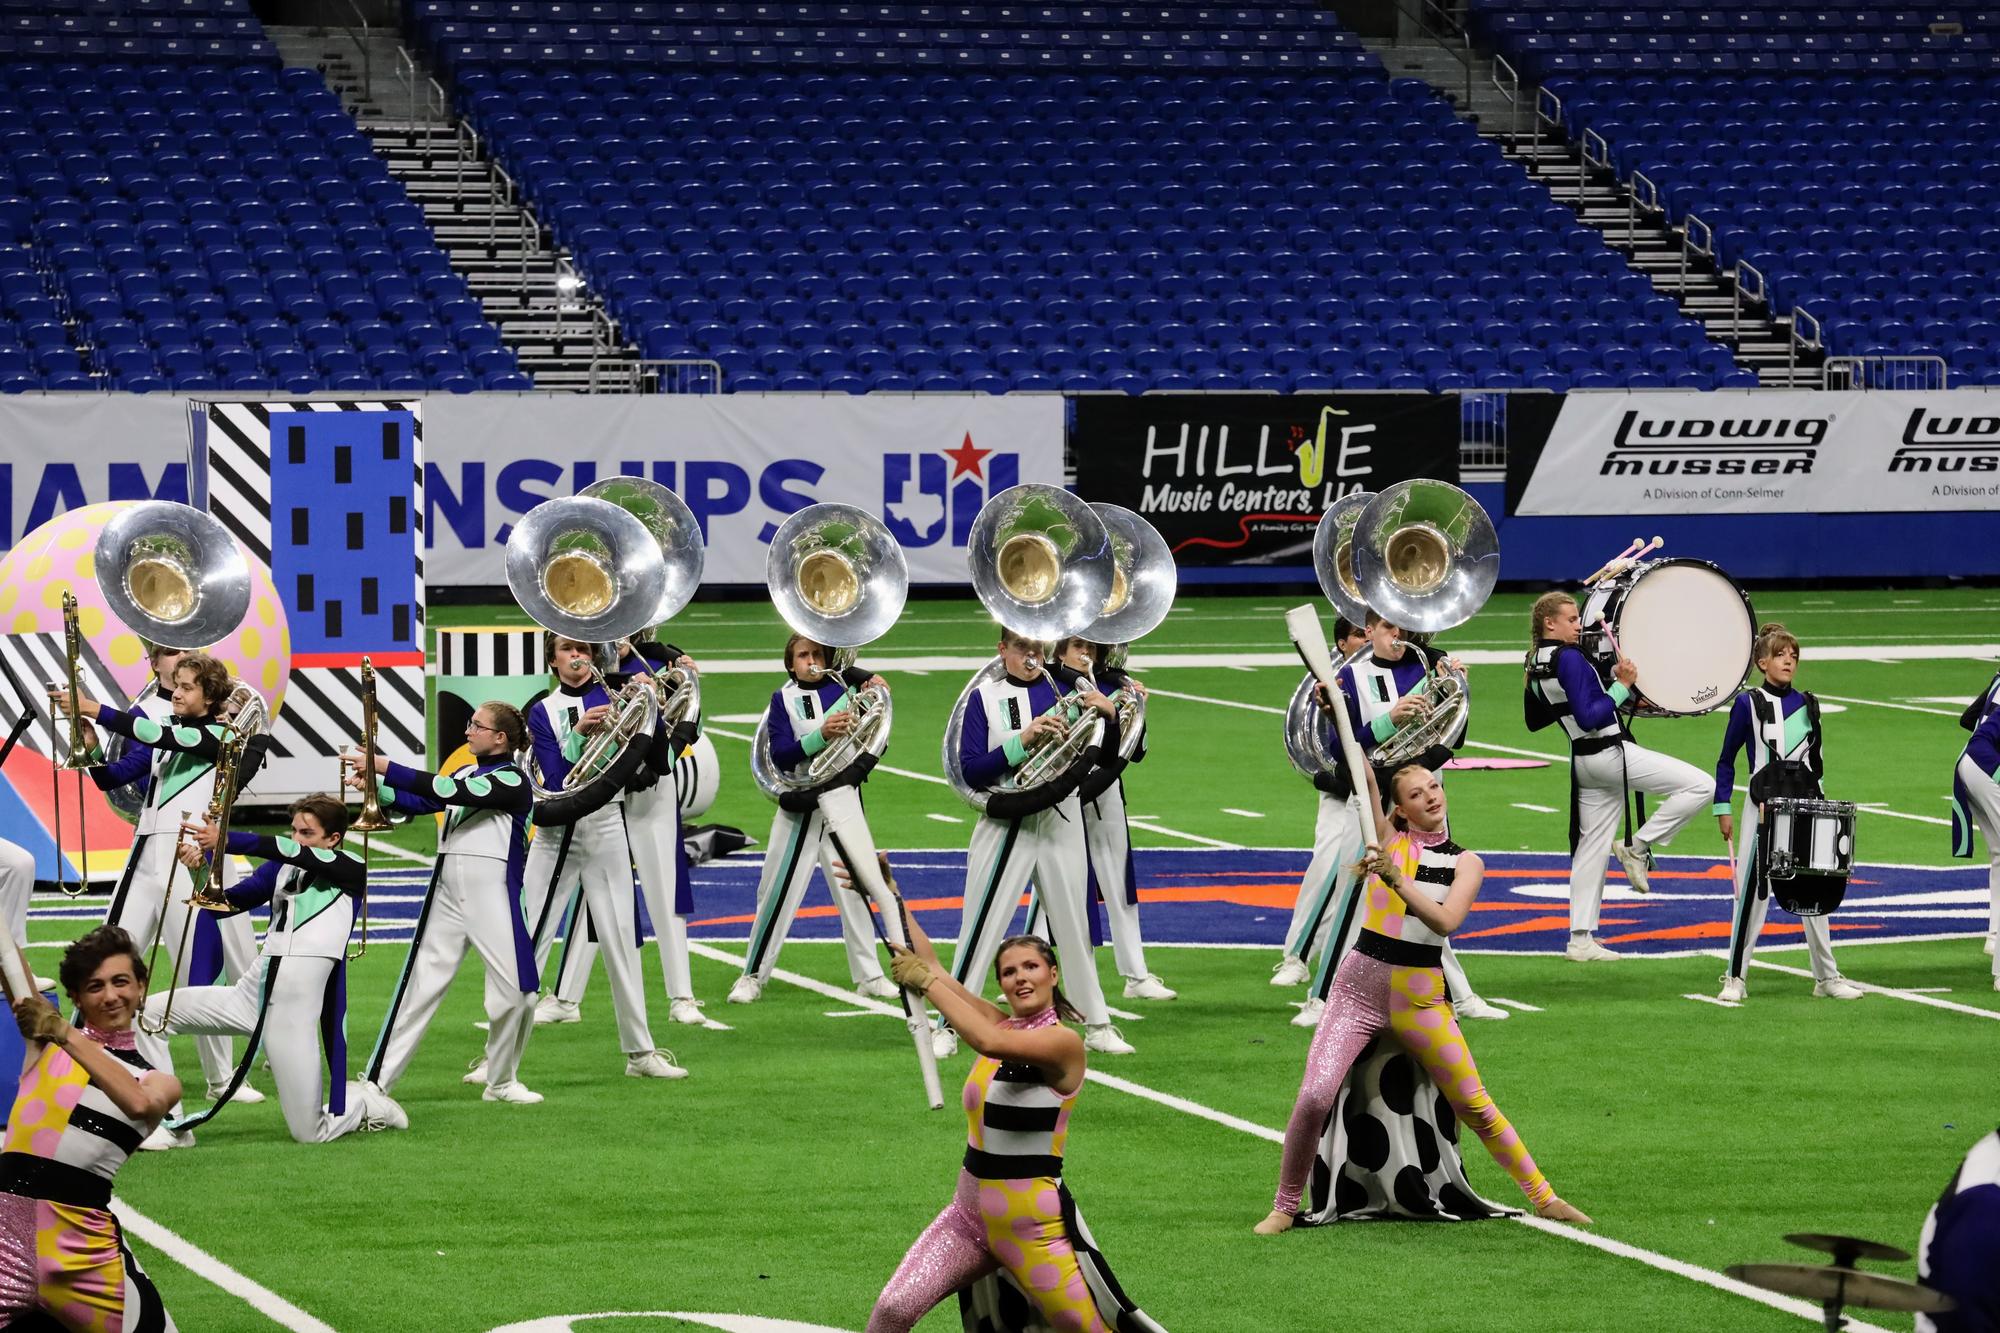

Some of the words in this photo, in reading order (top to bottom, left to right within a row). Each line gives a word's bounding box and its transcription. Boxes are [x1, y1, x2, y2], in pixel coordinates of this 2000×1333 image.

[1643, 488, 1651, 499] A
[1654, 487, 1697, 499] Division
[1701, 487, 1713, 499] of
[1714, 487, 1784, 499] Conn-Selmer
[1932, 485, 1940, 496] A
[1943, 484, 1986, 496] Division
[1988, 484, 2000, 496] of
[1140, 483, 1211, 513] Music
[1218, 482, 1314, 514] Centers,
[1251, 524, 1259, 532] A
